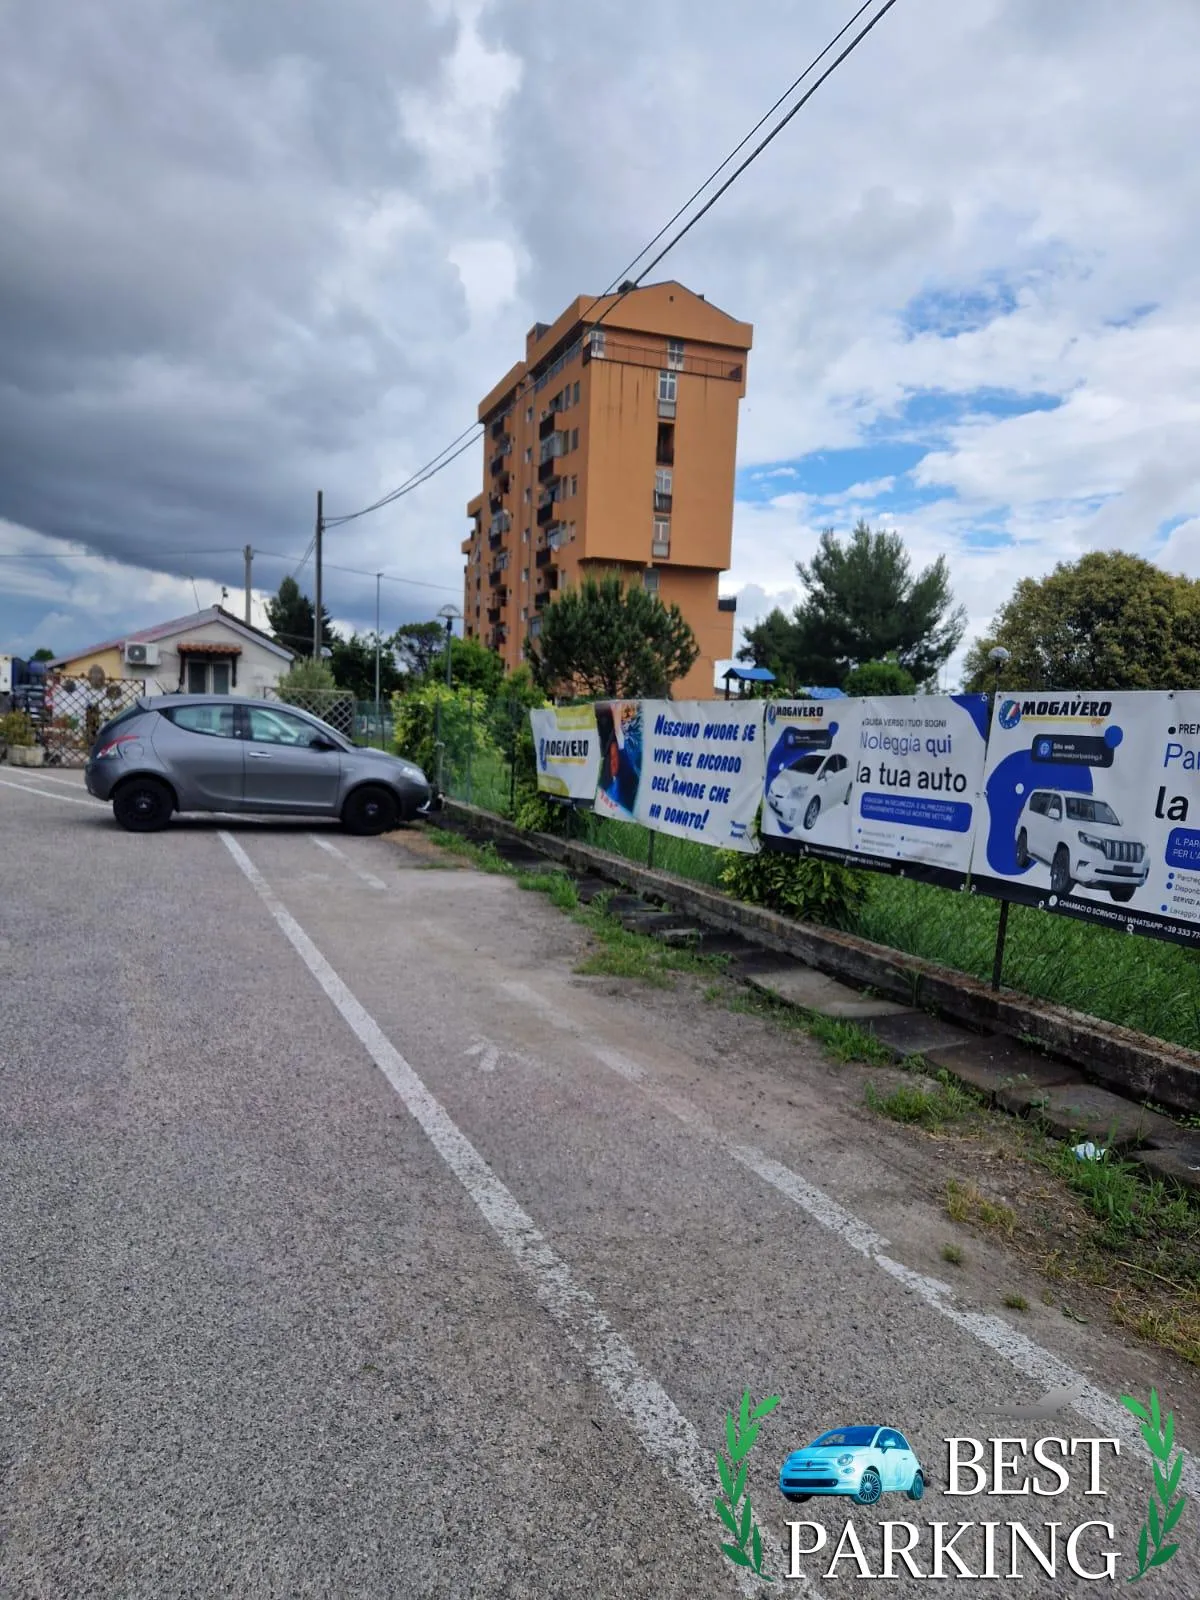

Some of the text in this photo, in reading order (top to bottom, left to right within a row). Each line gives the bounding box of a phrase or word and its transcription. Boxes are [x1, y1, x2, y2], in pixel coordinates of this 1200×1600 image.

[776, 706, 824, 717] MOGAVERO
[1021, 701, 1113, 717] MOGAVERO
[654, 714, 757, 742] NESSUNO MUORE SE
[884, 719, 904, 727] VERSO
[860, 731, 952, 758] Noleggia qui
[654, 748, 742, 773] VIVE NEL RICORDO
[651, 773, 731, 804] DELL'AMORE CHE
[856, 760, 967, 793] la tua auto
[649, 803, 662, 819] HA
[664, 807, 710, 831] DONATO!
[1154, 785, 1189, 822] la
[1172, 848, 1189, 859] PER
[1059, 900, 1086, 913] CHIAMACI
[1127, 916, 1164, 930] WHATSAPP
